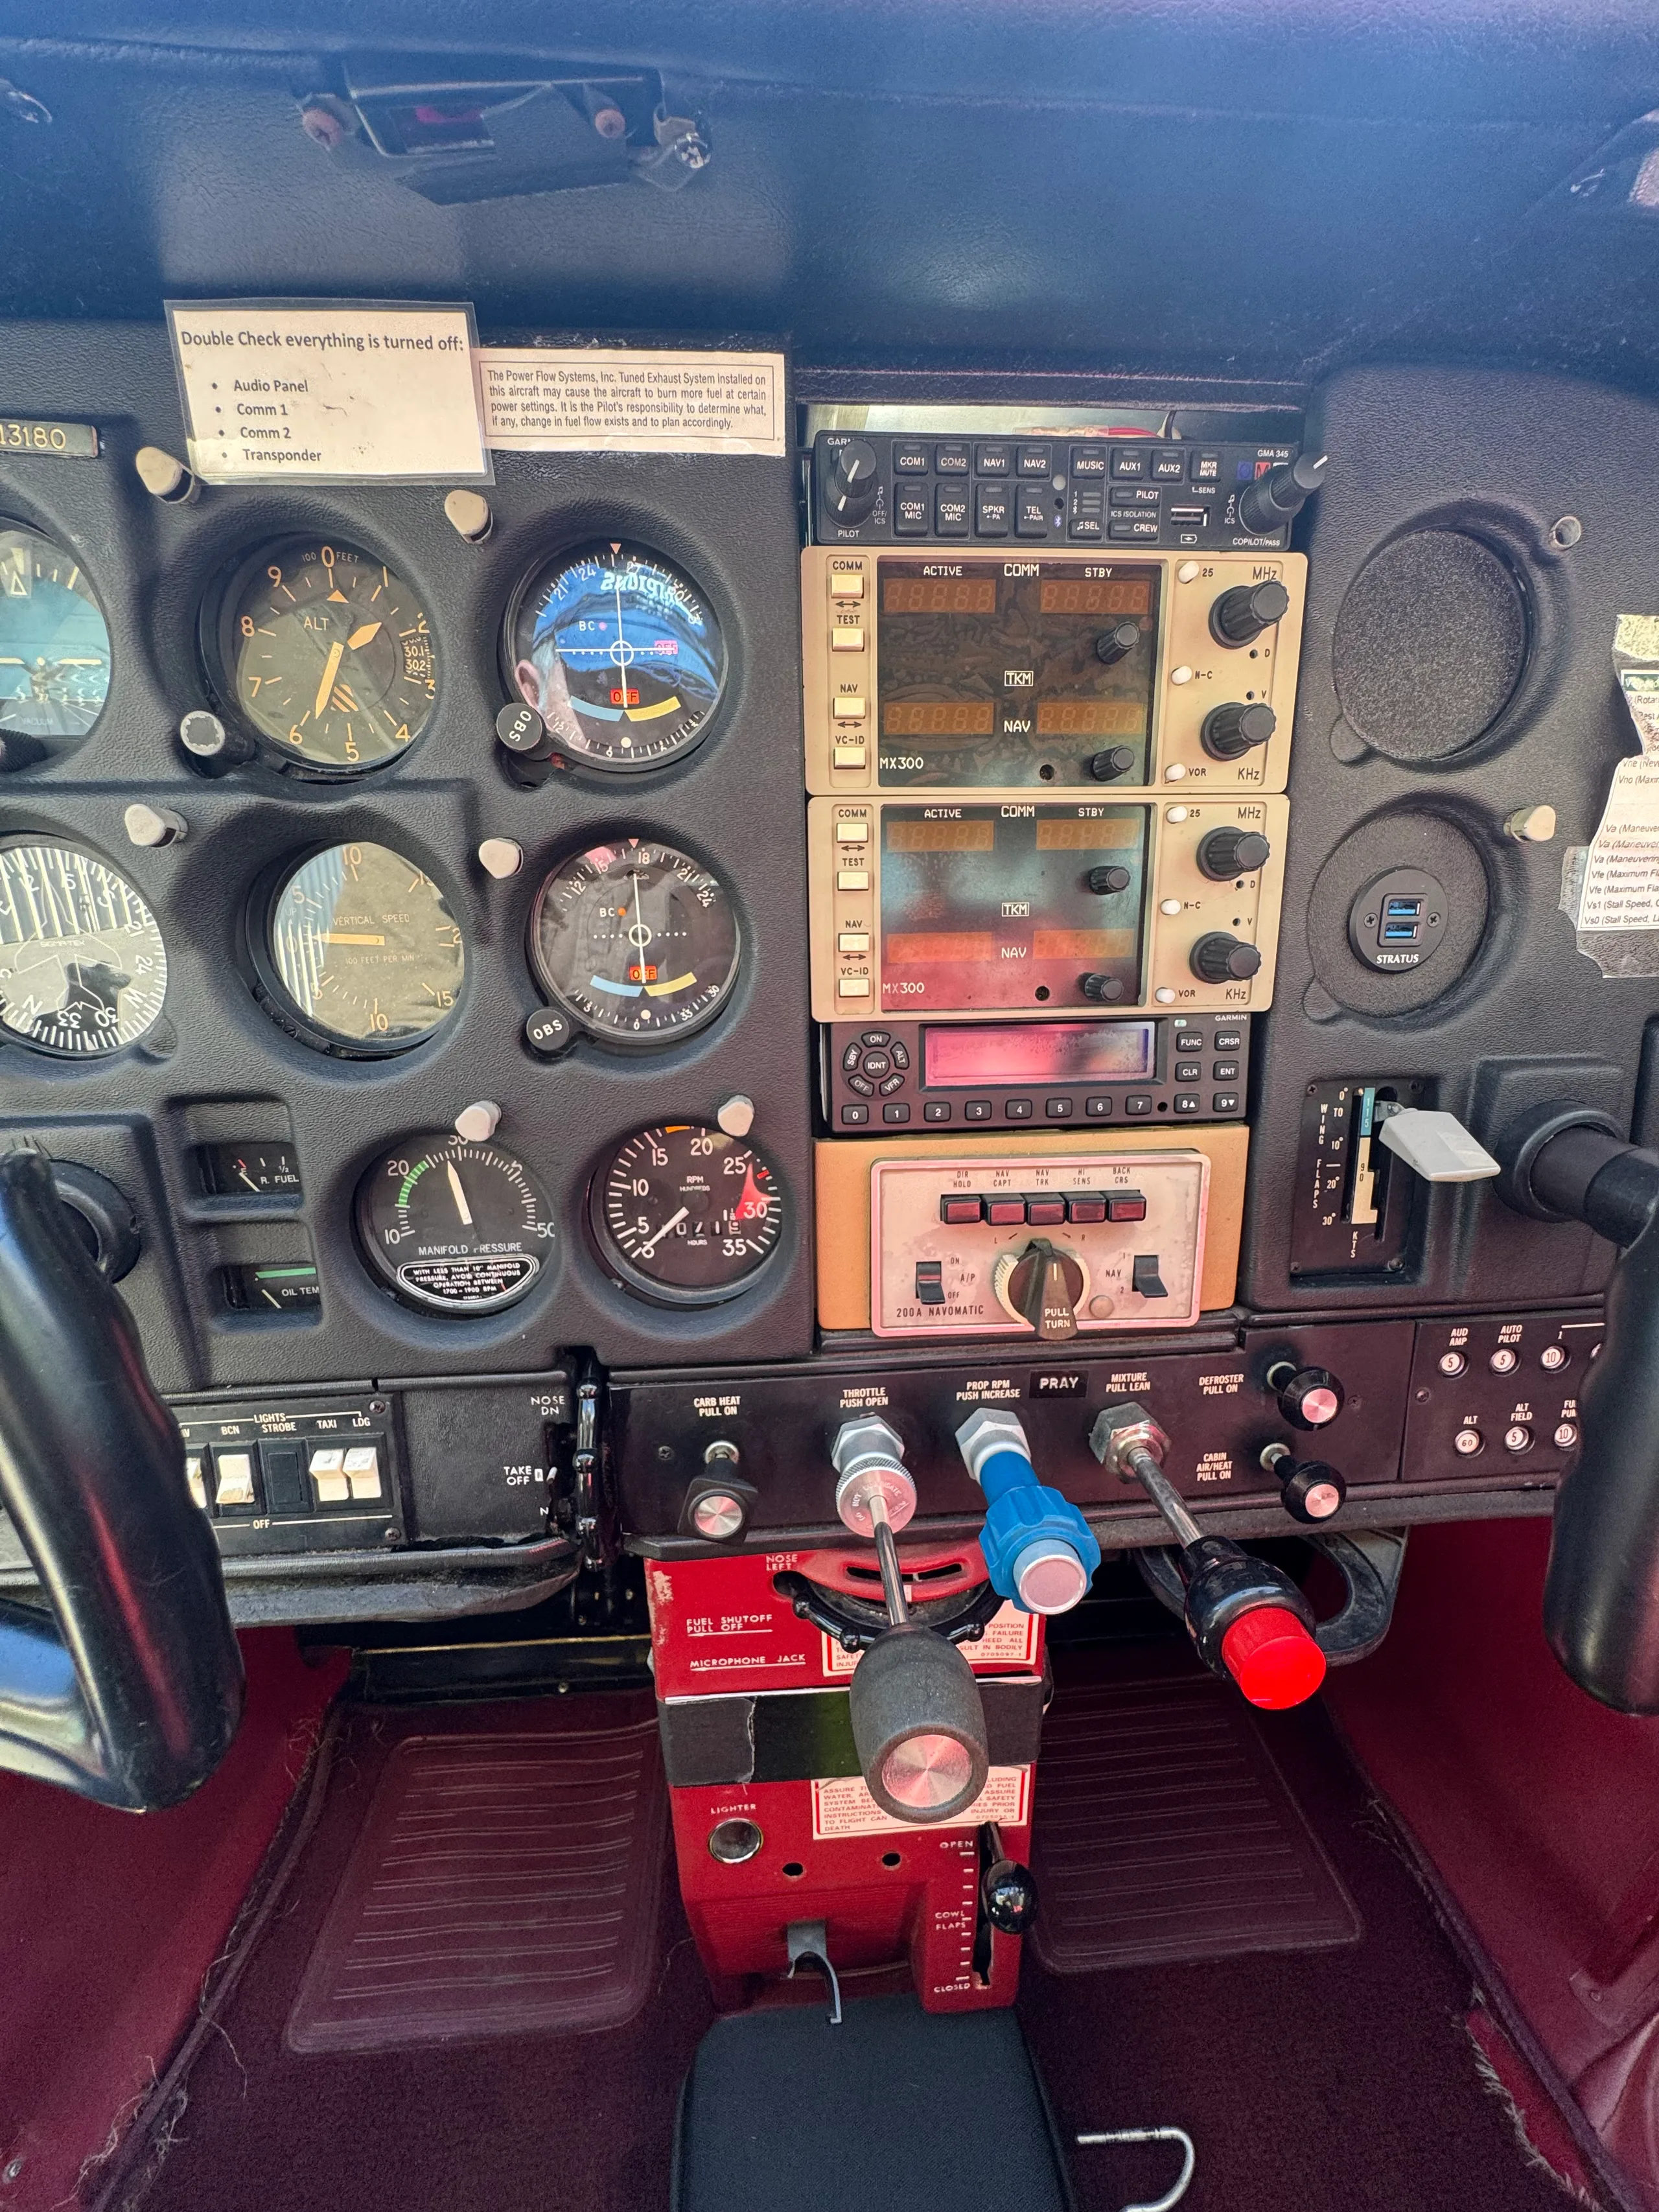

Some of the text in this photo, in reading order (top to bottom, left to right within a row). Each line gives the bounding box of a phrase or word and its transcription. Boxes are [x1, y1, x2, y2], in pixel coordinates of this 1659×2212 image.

[181, 331, 464, 353] Double Check everything is turned off:
[488, 370, 504, 381] The
[506, 371, 533, 381] Power
[537, 371, 556, 382] Flow
[559, 371, 598, 384] Systems,
[601, 371, 616, 382] Inc.
[619, 372, 645, 383] Tuned
[648, 372, 681, 384] Exhaust
[684, 373, 715, 386] System
[756, 377, 766, 385] on
[233, 378, 308, 393] Audio Panel
[490, 385, 766, 400] this aircraft may cause the aircraft to burn more fuel at certain
[237, 402, 288, 416] Comm 1
[491, 401, 766, 416] power settings. It is the Pilot's responsibility to determine what,
[493, 415, 733, 430] if any, change in fuel flow exists and to plan accordingly.
[240, 425, 291, 440] Comm 2
[242, 447, 321, 464] Transponder
[1275, 450, 1289, 458] 345
[900, 458, 925, 466] COM1
[941, 458, 966, 467] COM2
[984, 459, 1005, 467] NAV1
[1024, 460, 1046, 469] NAV2
[1077, 461, 1104, 470] MUSIC
[1119, 462, 1141, 471] AUX1
[1158, 464, 1180, 473] AUX2
[1136, 491, 1159, 499] PILOT
[900, 502, 925, 511] COM1
[940, 504, 966, 513] COM2
[1027, 506, 1041, 515] TEL
[1133, 524, 1157, 533] CREW
[1233, 537, 1281, 546] COPILOT/PASS
[336, 552, 359, 563] FEET
[832, 561, 863, 571] COMM
[923, 563, 1112, 578] ACTIVE COMM STBY
[1252, 566, 1277, 581] MHz
[304, 616, 330, 631] ALT
[836, 615, 860, 625] TEST
[1006, 673, 1032, 684] TKM
[1004, 720, 1030, 733] NAV
[835, 736, 865, 745] VC-ID
[879, 757, 924, 770] MX300
[1238, 768, 1260, 781] KHz
[599, 907, 615, 917] BC
[333, 914, 410, 926] VERTICAL SPEED
[1601, 915, 1622, 925] (Stall
[1623, 914, 1651, 925] Speed,
[1376, 954, 1419, 964] STRATUS
[533, 1019, 563, 1040] OBS
[1181, 1038, 1202, 1047] FUNC
[1218, 1038, 1240, 1046] CRSR
[867, 1061, 887, 1070] IDNT
[1220, 1067, 1235, 1076] ENT
[691, 1138, 713, 1156] 20
[388, 1160, 410, 1176] 20
[723, 1157, 746, 1174] 25
[261, 1174, 299, 1185] R. FUEL
[419, 1245, 469, 1256] MANIFOLD
[723, 1239, 747, 1256] 35
[896, 1305, 984, 1317] 200A NAVOMATIC
[1044, 1309, 1069, 1318] PULL
[1045, 1319, 1071, 1329] TURN
[1501, 1325, 1522, 1334] AUTO
[1498, 1334, 1522, 1344] PILOT
[1111, 1373, 1147, 1382] MIXTURE
[1199, 1374, 1244, 1386] DEFROSTER
[966, 1380, 1010, 1390] PROP RPM
[1039, 1377, 1078, 1390] PRAY
[1106, 1382, 1150, 1393] PULL LEAN
[843, 1387, 886, 1398] THROTTLE
[957, 1388, 1021, 1401] PUSH INCREASE
[693, 1395, 741, 1407] CARB HEAT
[840, 1396, 888, 1408] PUSH OPEN
[699, 1406, 737, 1417] PULL ON
[254, 1412, 286, 1423] LIGHTS
[353, 1417, 371, 1428] LDG
[262, 1421, 296, 1433] STROBE
[316, 1419, 337, 1430] TAXI
[221, 1426, 240, 1436] BCN
[1203, 1452, 1227, 1462] CABIN
[504, 1467, 532, 1476] TAKE
[1196, 1461, 1232, 1472] AIR/HEAT
[506, 1476, 529, 1486] OFF
[686, 1614, 772, 1626] FUEL SHUTOFF
[690, 1653, 806, 1668] MICROPHONE JACK
[711, 1804, 756, 1814] LIGHTER
[940, 1840, 973, 1849] OPEN
[933, 1982, 971, 1993] CLOSED
